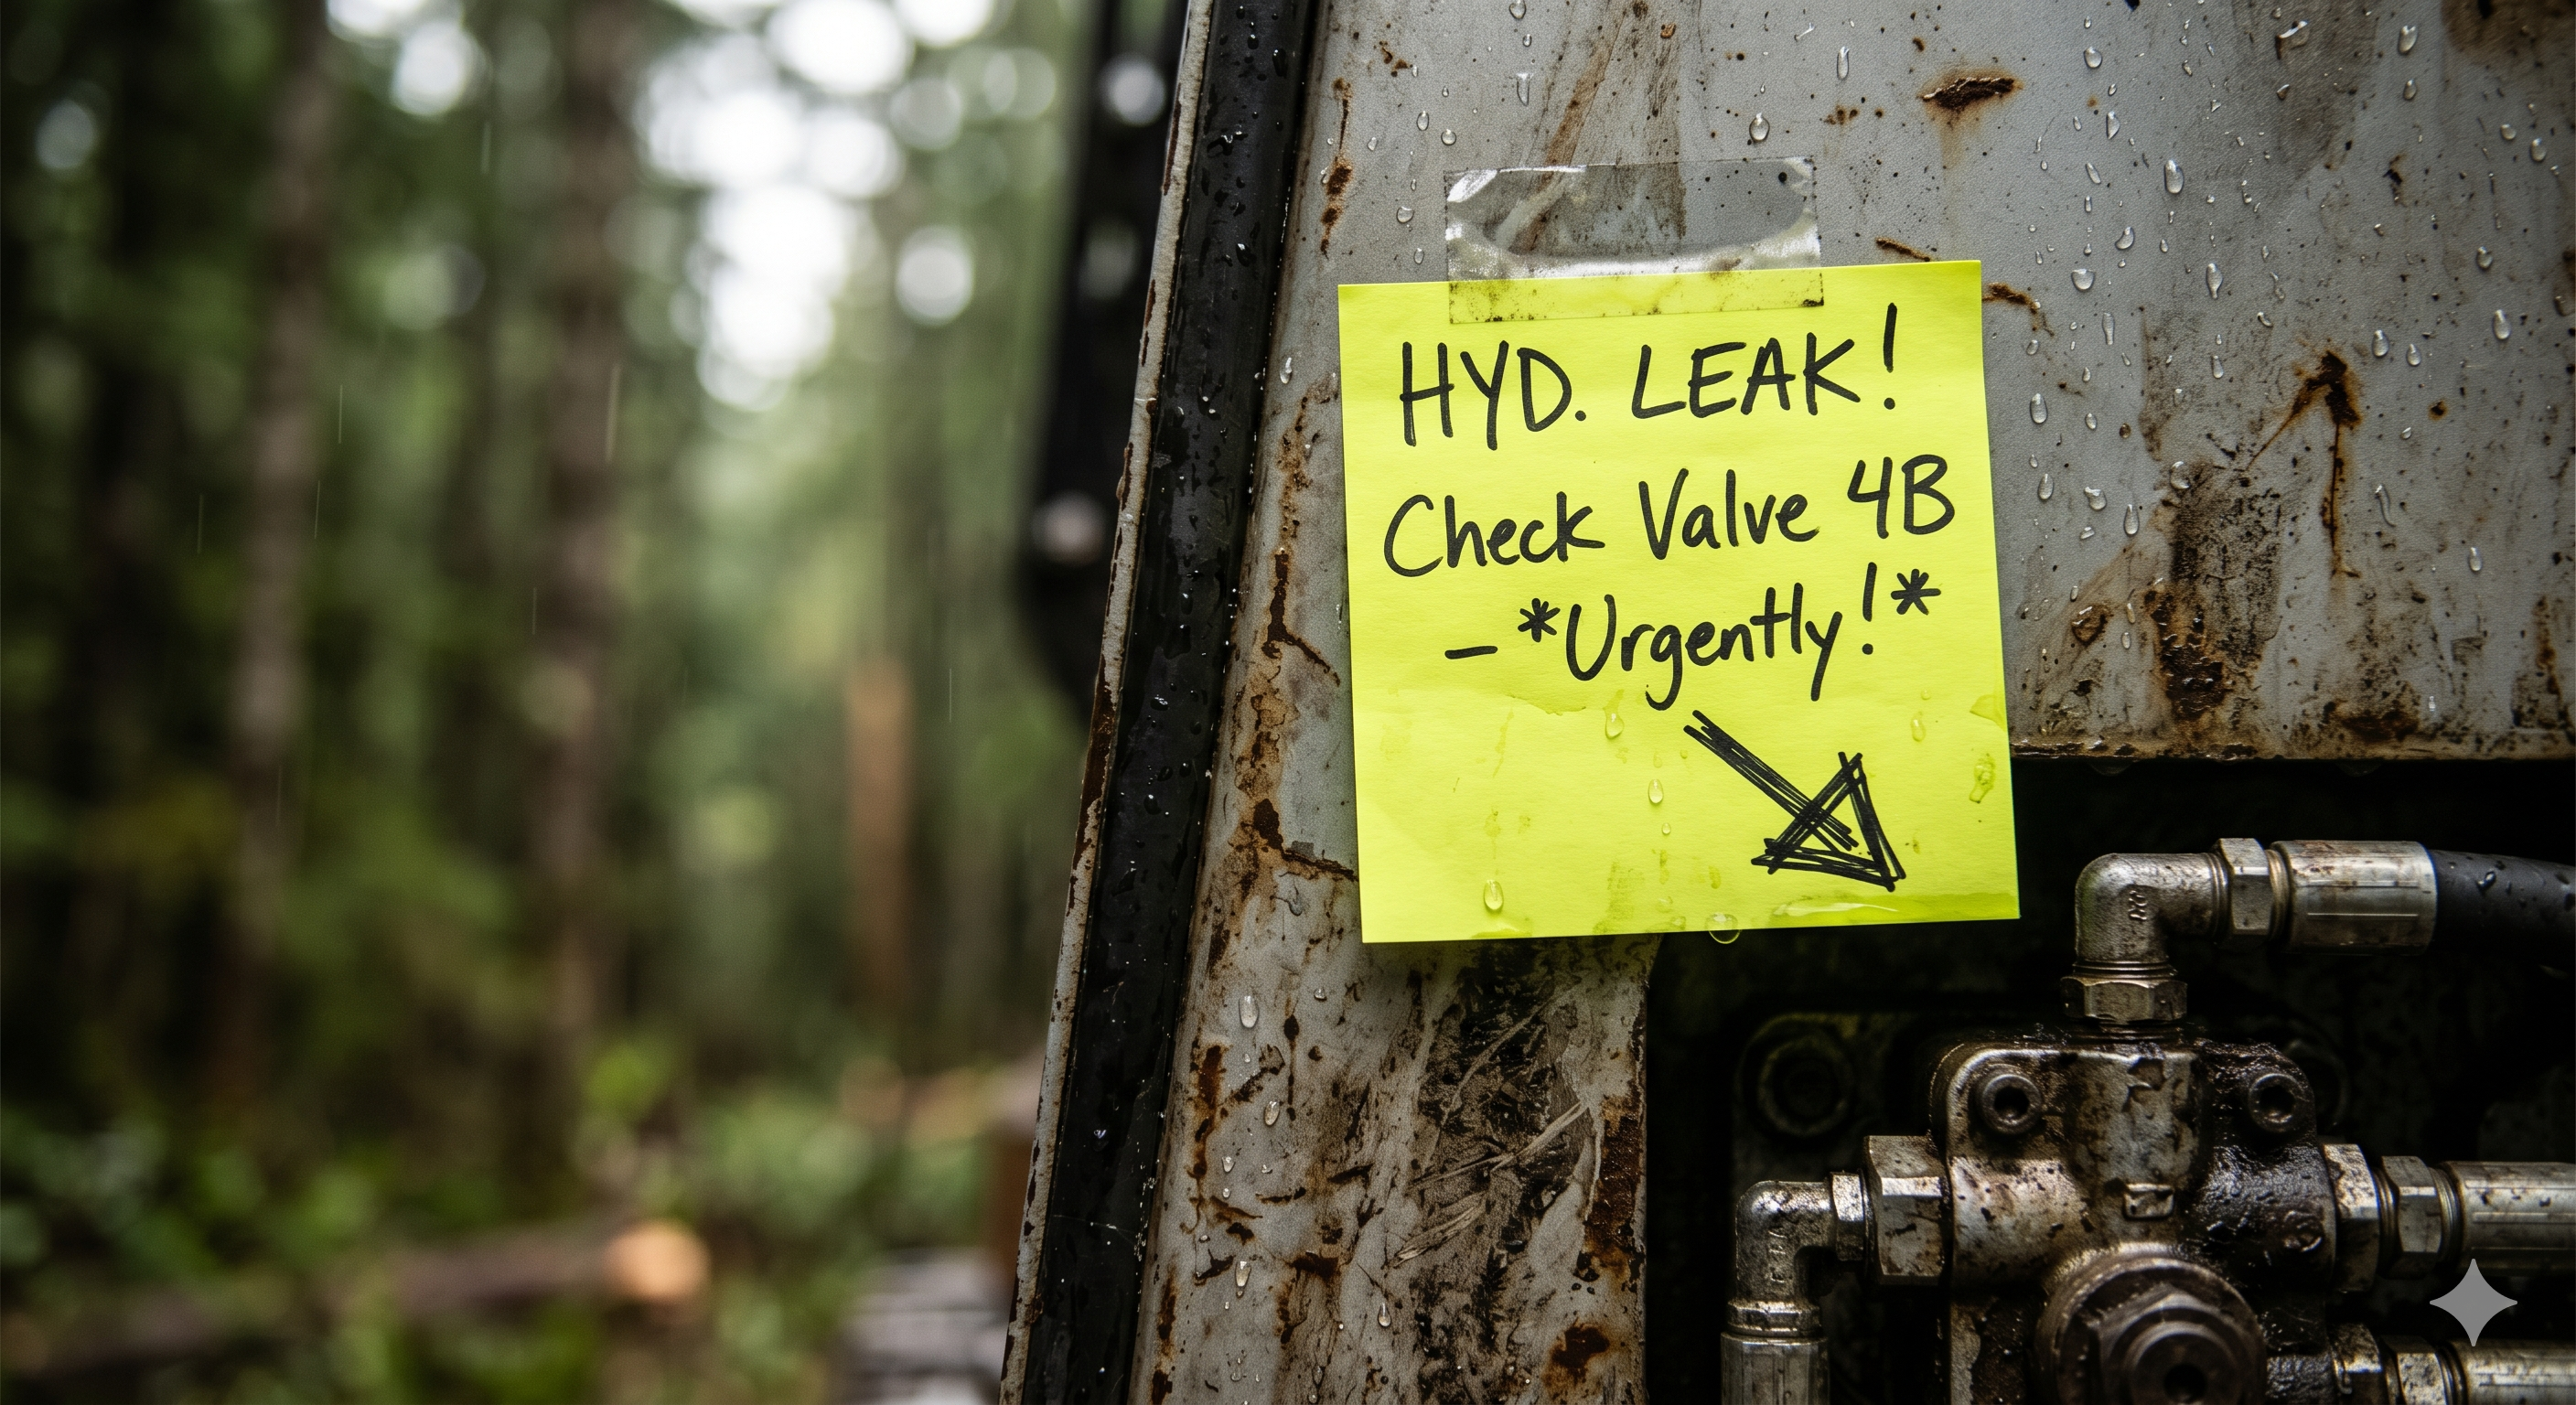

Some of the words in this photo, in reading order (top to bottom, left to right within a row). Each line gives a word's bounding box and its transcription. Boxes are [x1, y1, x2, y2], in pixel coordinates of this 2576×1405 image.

[1399, 339, 1587, 451] HYD.
[1631, 302, 1898, 419] LEAK!
[1383, 491, 1605, 578] Check
[1638, 467, 1819, 561] Valve
[1847, 454, 1956, 540] 4B
